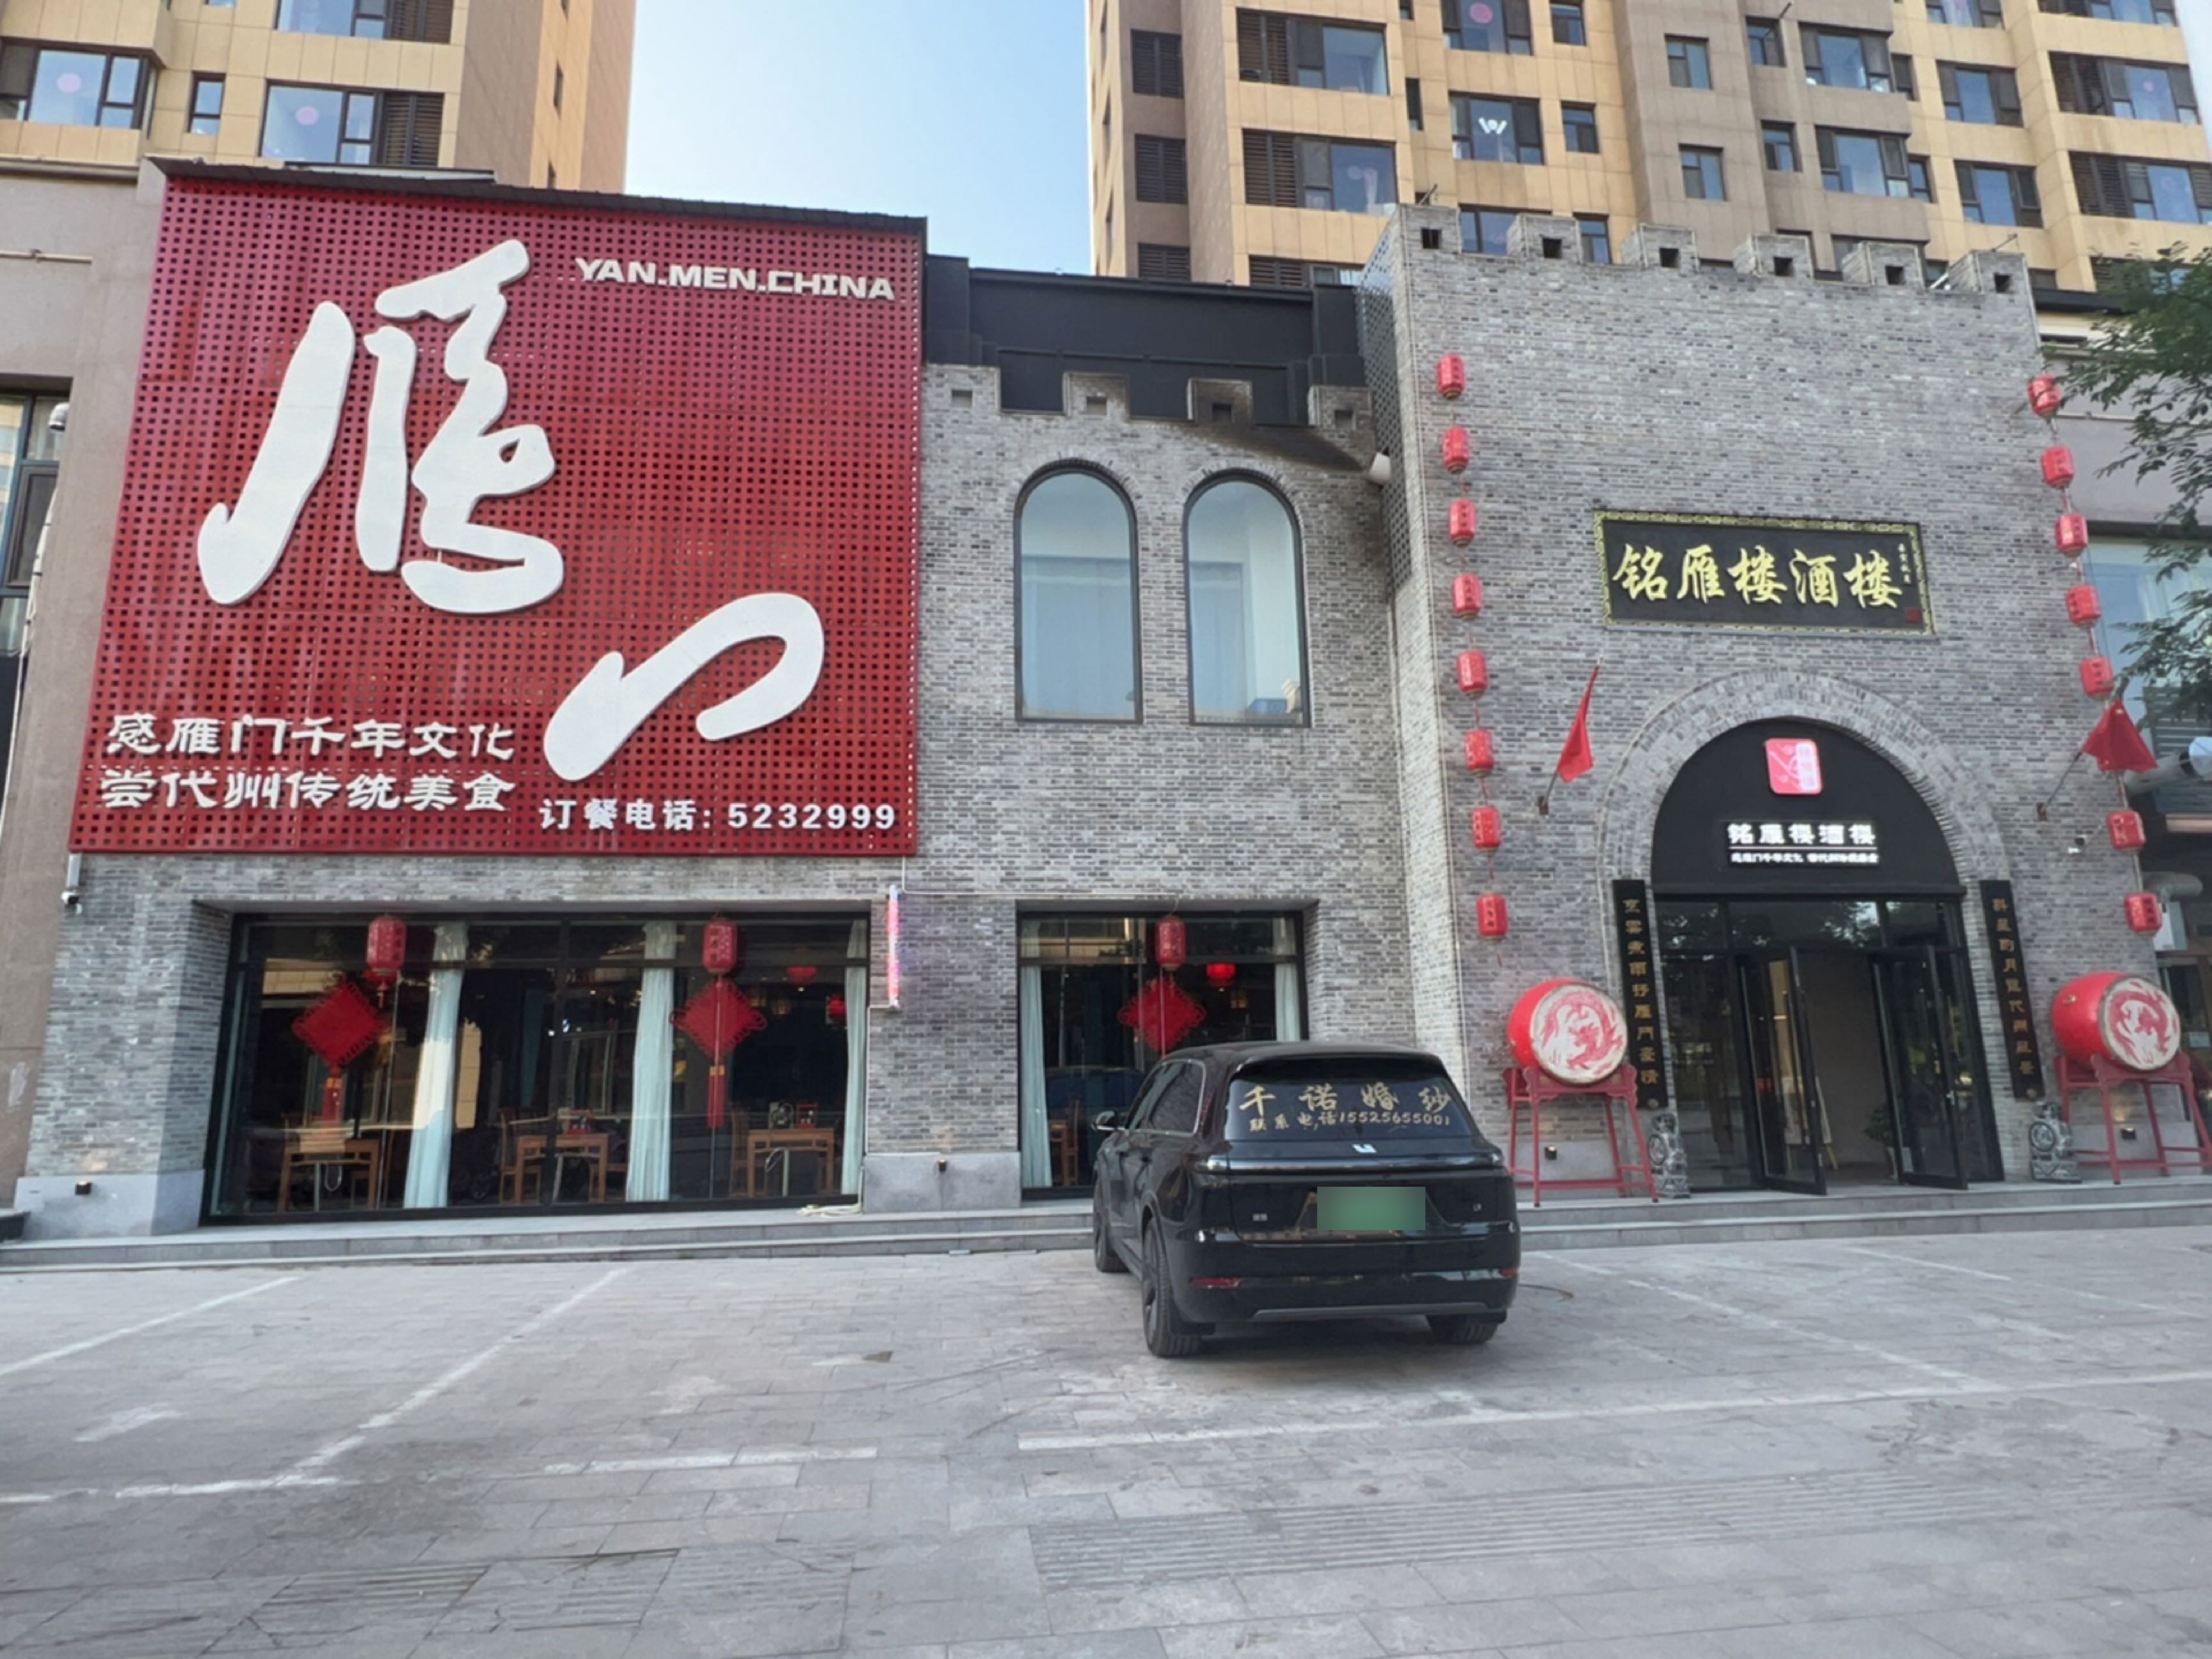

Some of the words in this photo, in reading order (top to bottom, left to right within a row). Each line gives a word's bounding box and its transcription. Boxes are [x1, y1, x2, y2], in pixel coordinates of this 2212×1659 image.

[575, 257, 895, 300] YAN.MEN.CHINA
[1612, 543, 1903, 609] 铭雁楼酒楼
[107, 712, 514, 760] 感雁门千年文化
[100, 769, 515, 812] 尝代州传统美食
